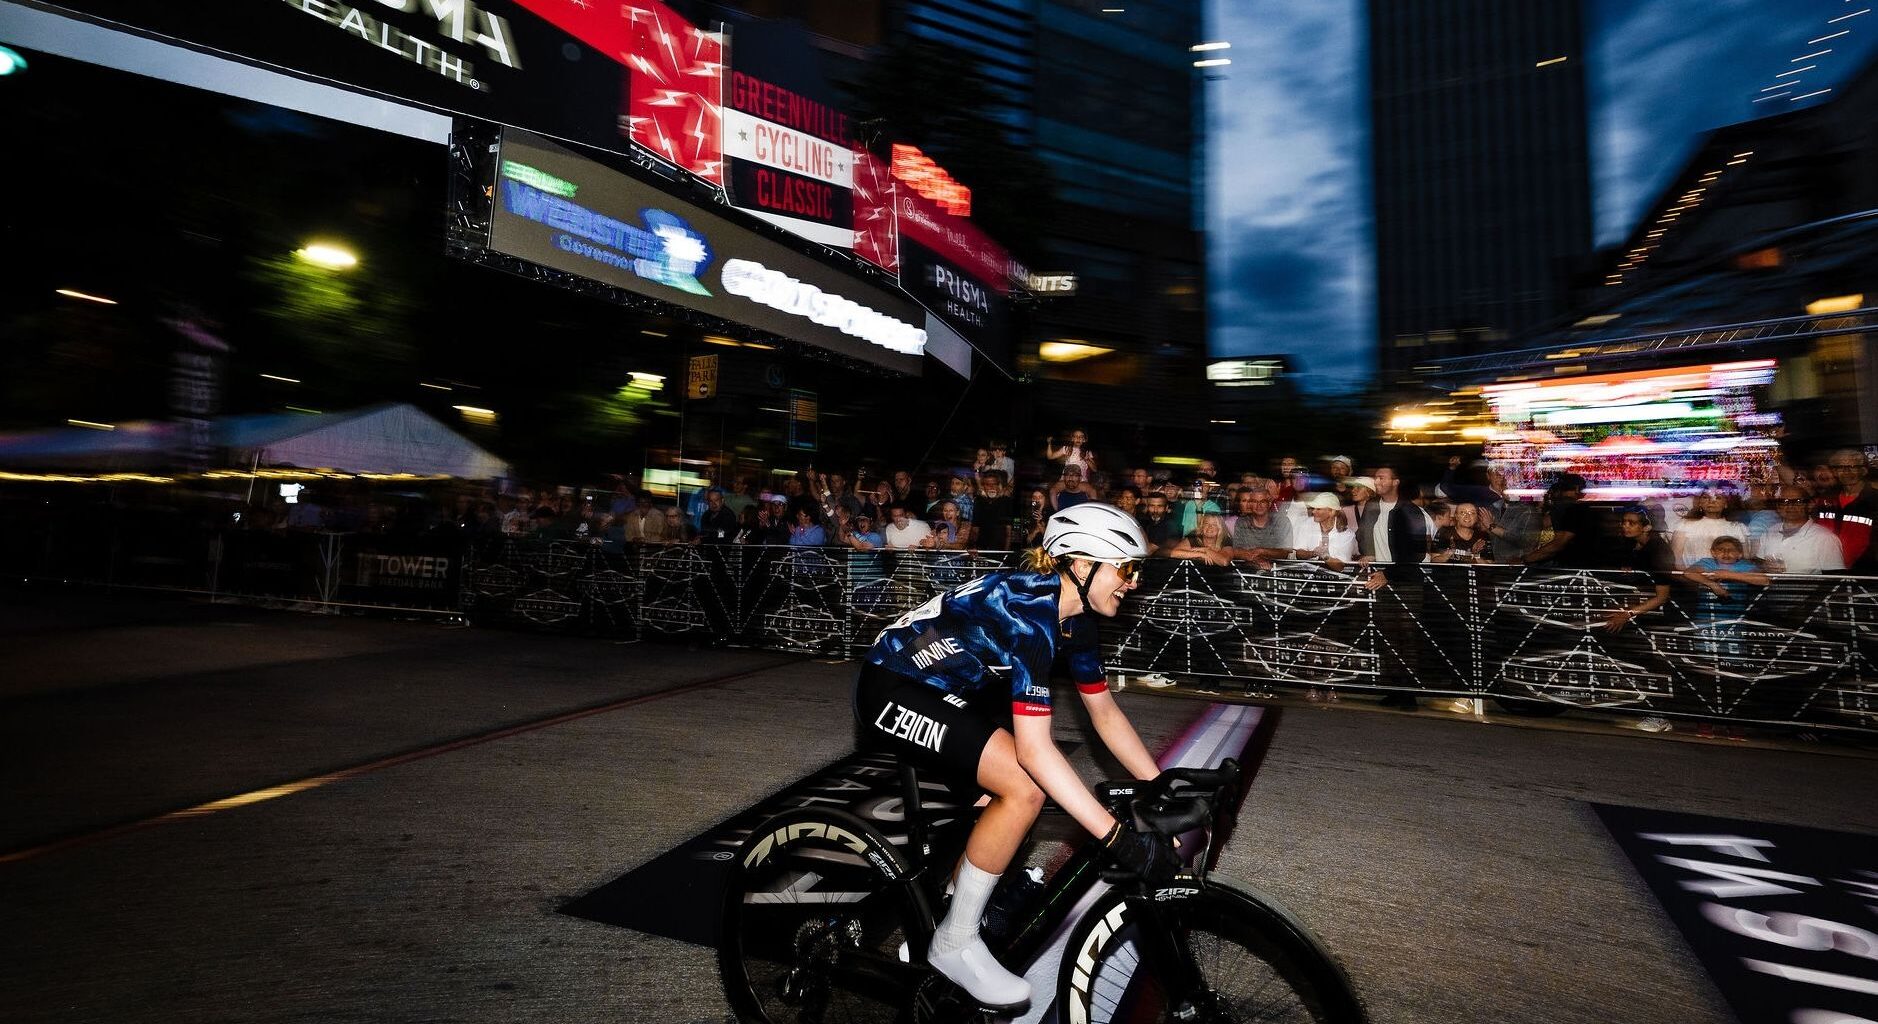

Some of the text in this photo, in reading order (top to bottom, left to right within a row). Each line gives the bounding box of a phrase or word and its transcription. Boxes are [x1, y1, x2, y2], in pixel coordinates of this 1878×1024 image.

[732, 71, 848, 145] GREENVILLE
[755, 123, 833, 179] CYCLING
[756, 169, 833, 220] CLASSIC
[935, 264, 989, 315] PRISMA
[376, 555, 449, 579] TOWER
[1155, 887, 1199, 897] ZIPP
